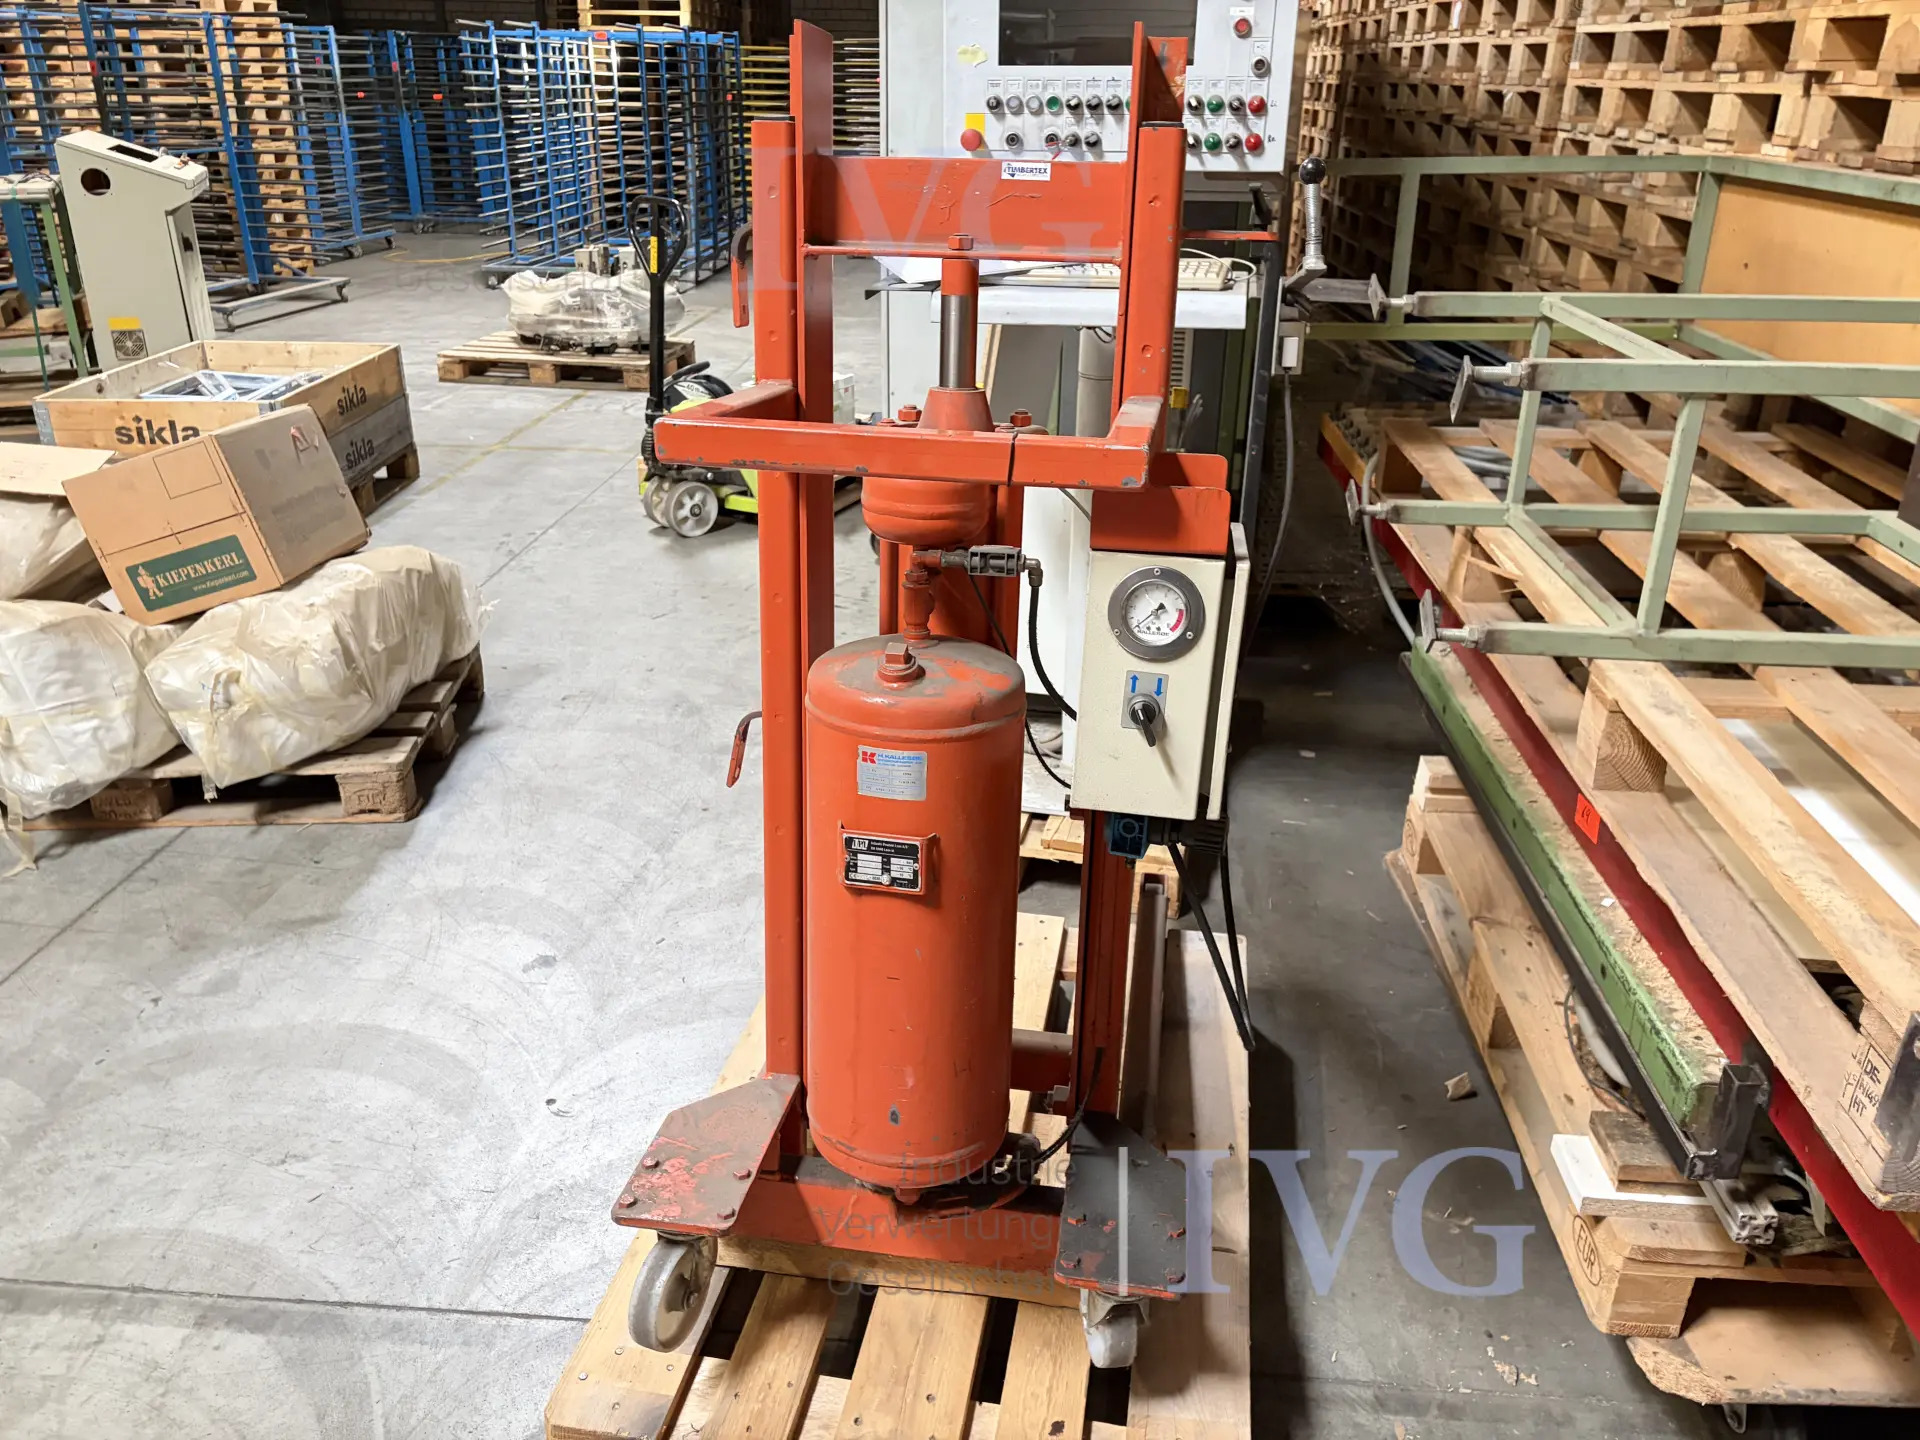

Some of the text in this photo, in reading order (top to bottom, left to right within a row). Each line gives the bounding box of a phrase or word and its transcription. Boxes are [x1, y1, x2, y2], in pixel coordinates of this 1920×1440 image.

[337, 385, 368, 416] sikla
[115, 415, 200, 446] sikla
[345, 437, 375, 470] sikla
[156, 552, 243, 587] KIEPENKERL
[1576, 1222, 1597, 1279] EUR
